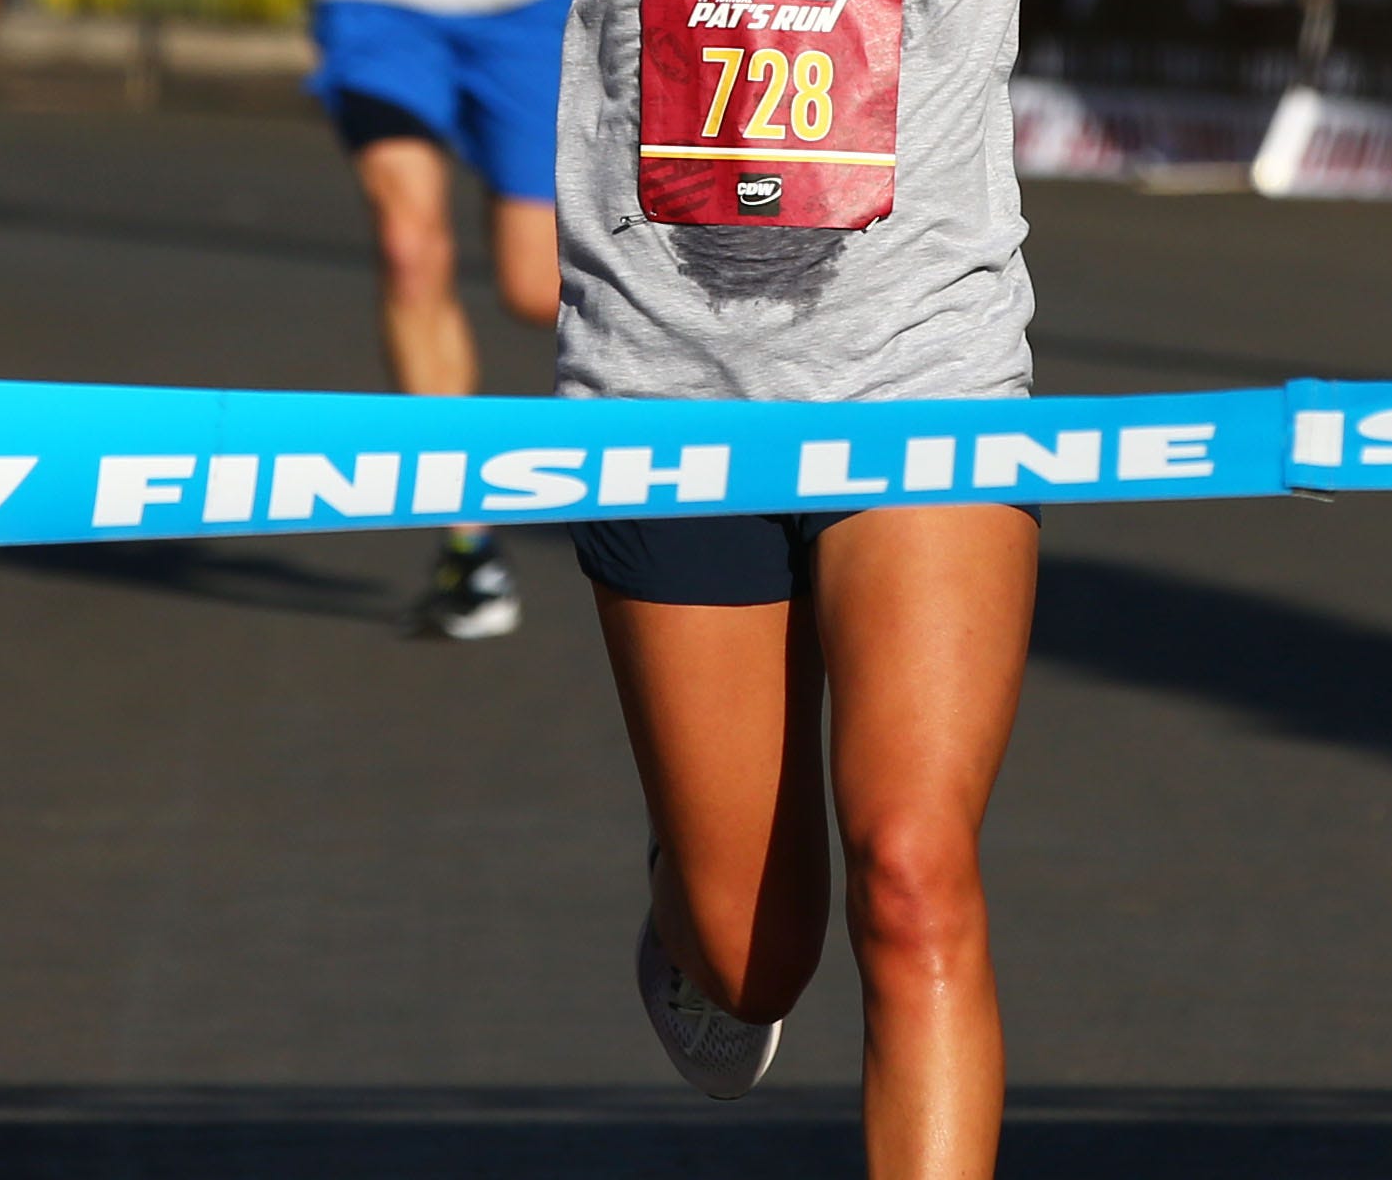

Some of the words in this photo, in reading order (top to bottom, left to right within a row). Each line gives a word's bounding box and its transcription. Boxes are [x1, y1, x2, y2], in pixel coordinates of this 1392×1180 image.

[688, 2, 775, 30] PAT'S
[701, 47, 834, 142] 728
[737, 181, 777, 197] CDW
[91, 442, 731, 530] FINISH
[796, 422, 1216, 499] LINE
